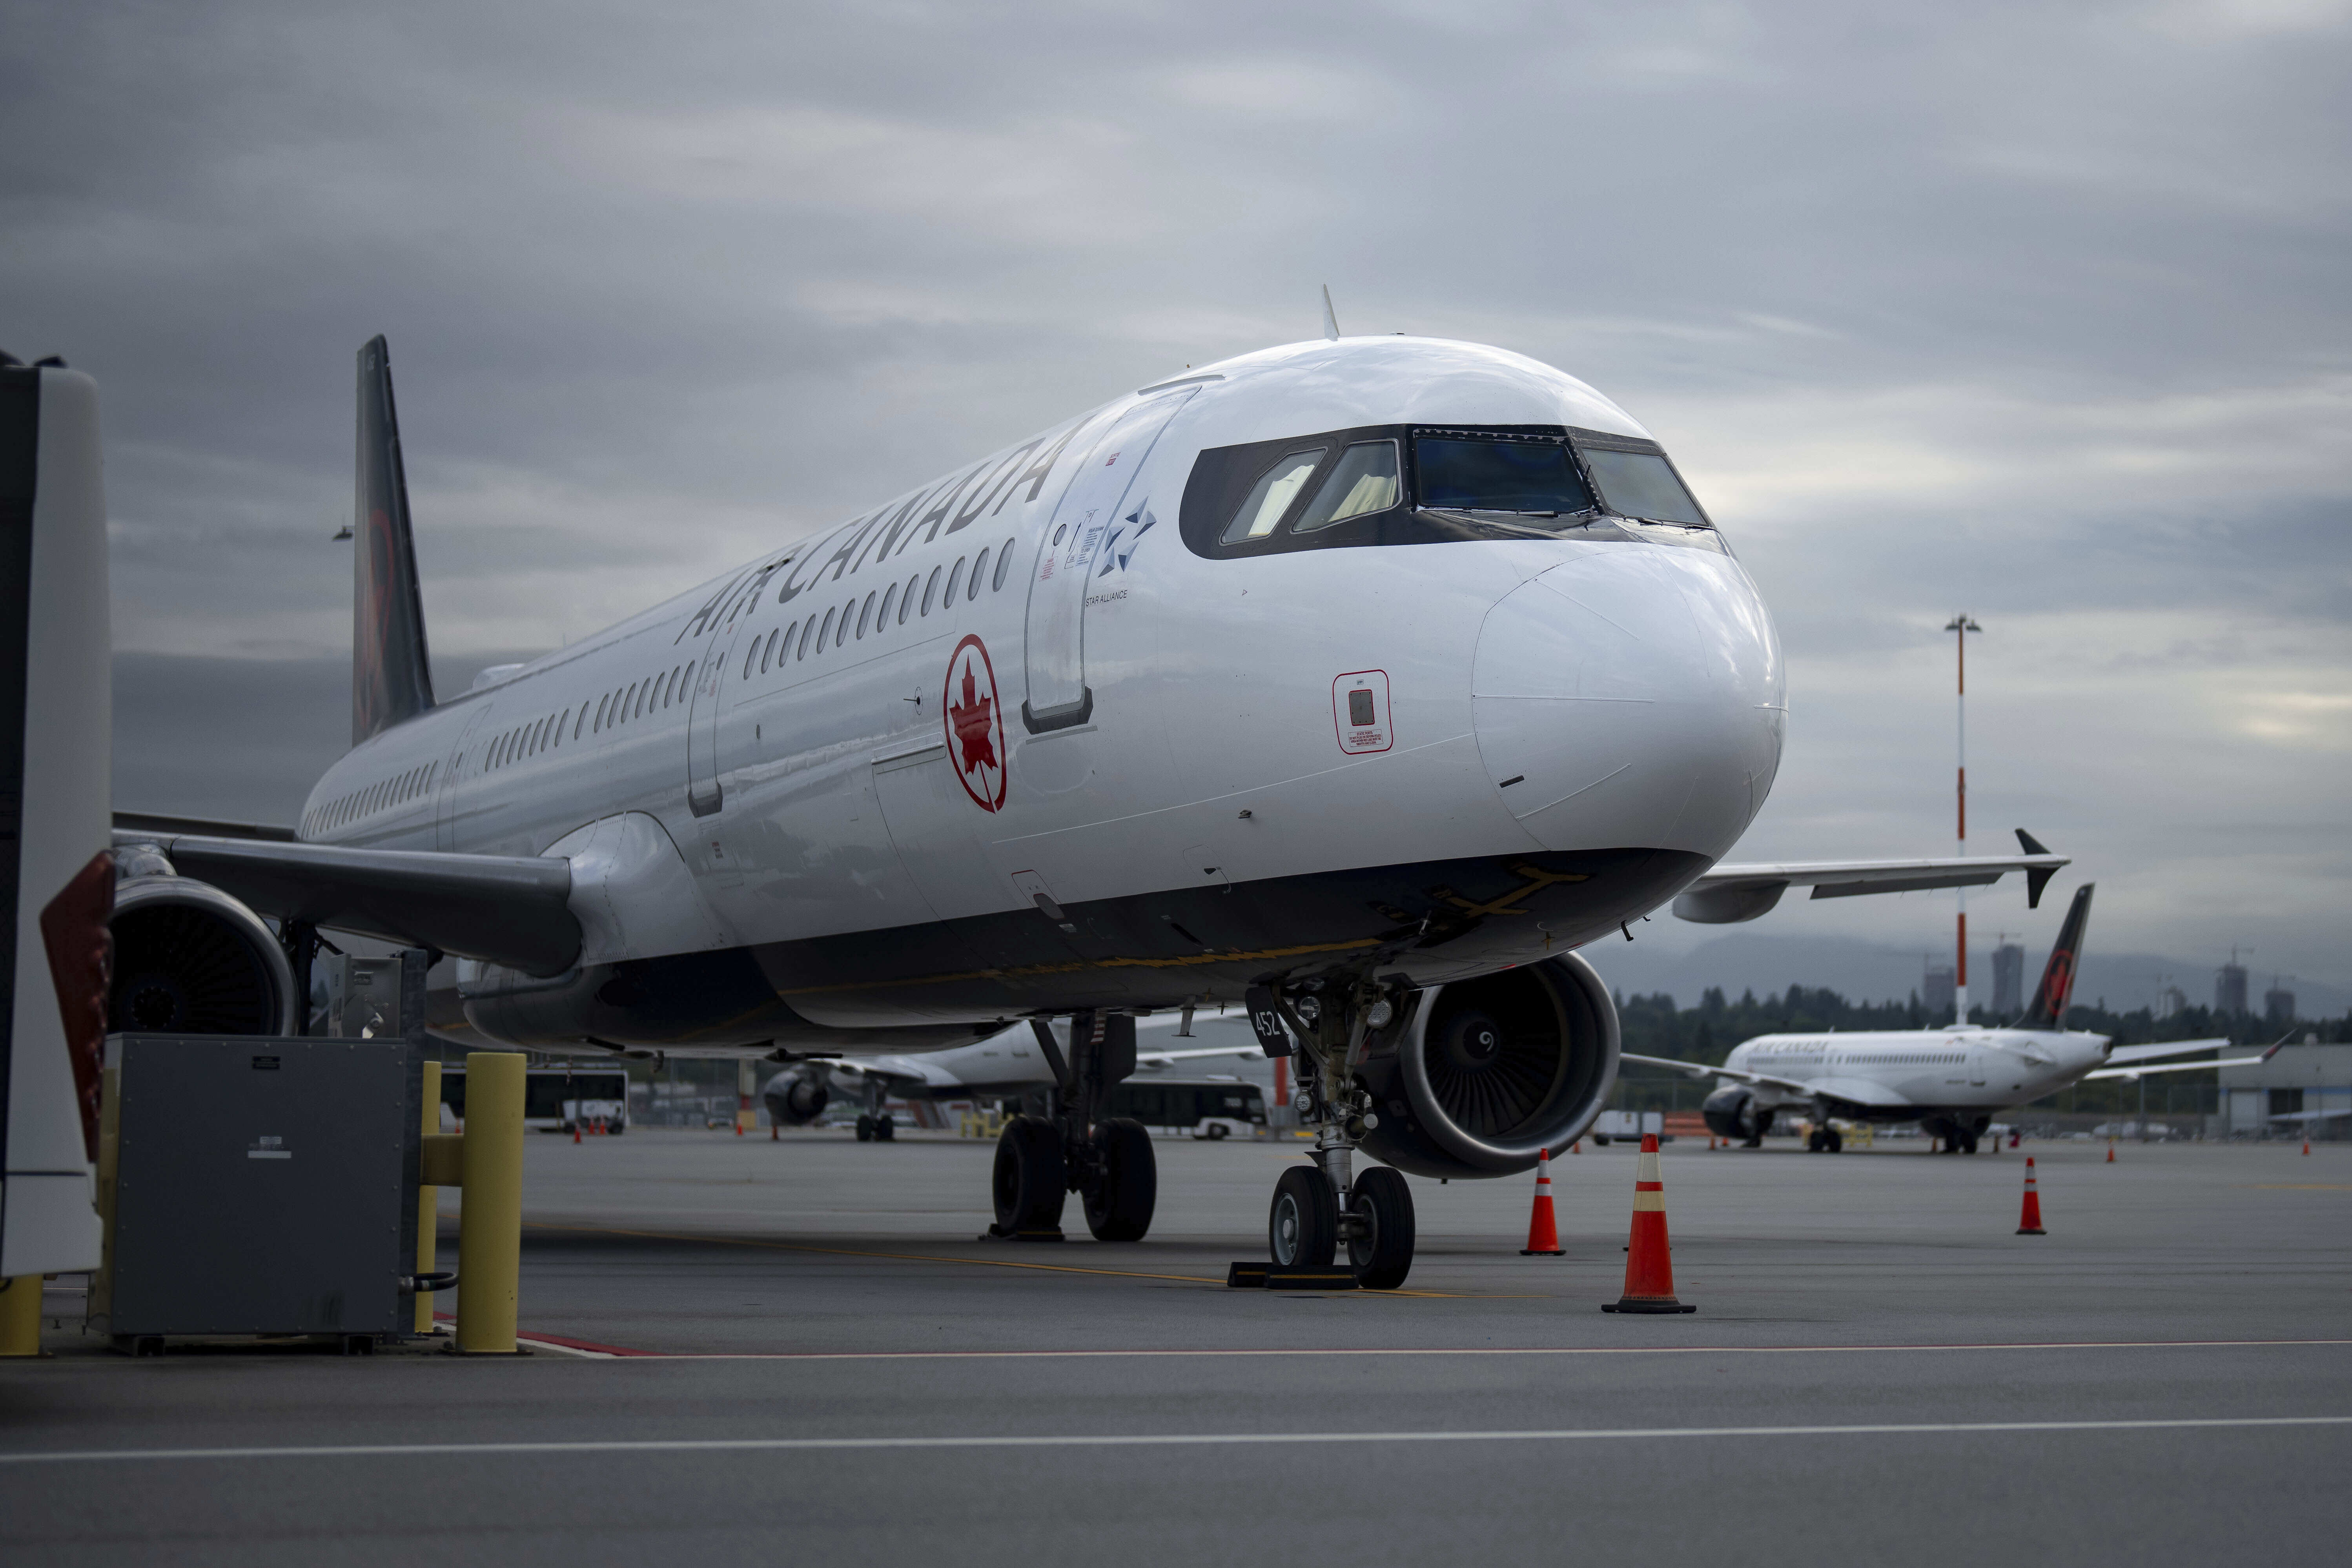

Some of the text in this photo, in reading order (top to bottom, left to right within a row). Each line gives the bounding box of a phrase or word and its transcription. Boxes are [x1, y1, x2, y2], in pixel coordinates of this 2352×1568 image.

[673, 413, 1098, 647] AIR CANADA
[1086, 590, 1128, 606] STAR ALLIANCE
[1256, 1011, 1280, 1036] 452
